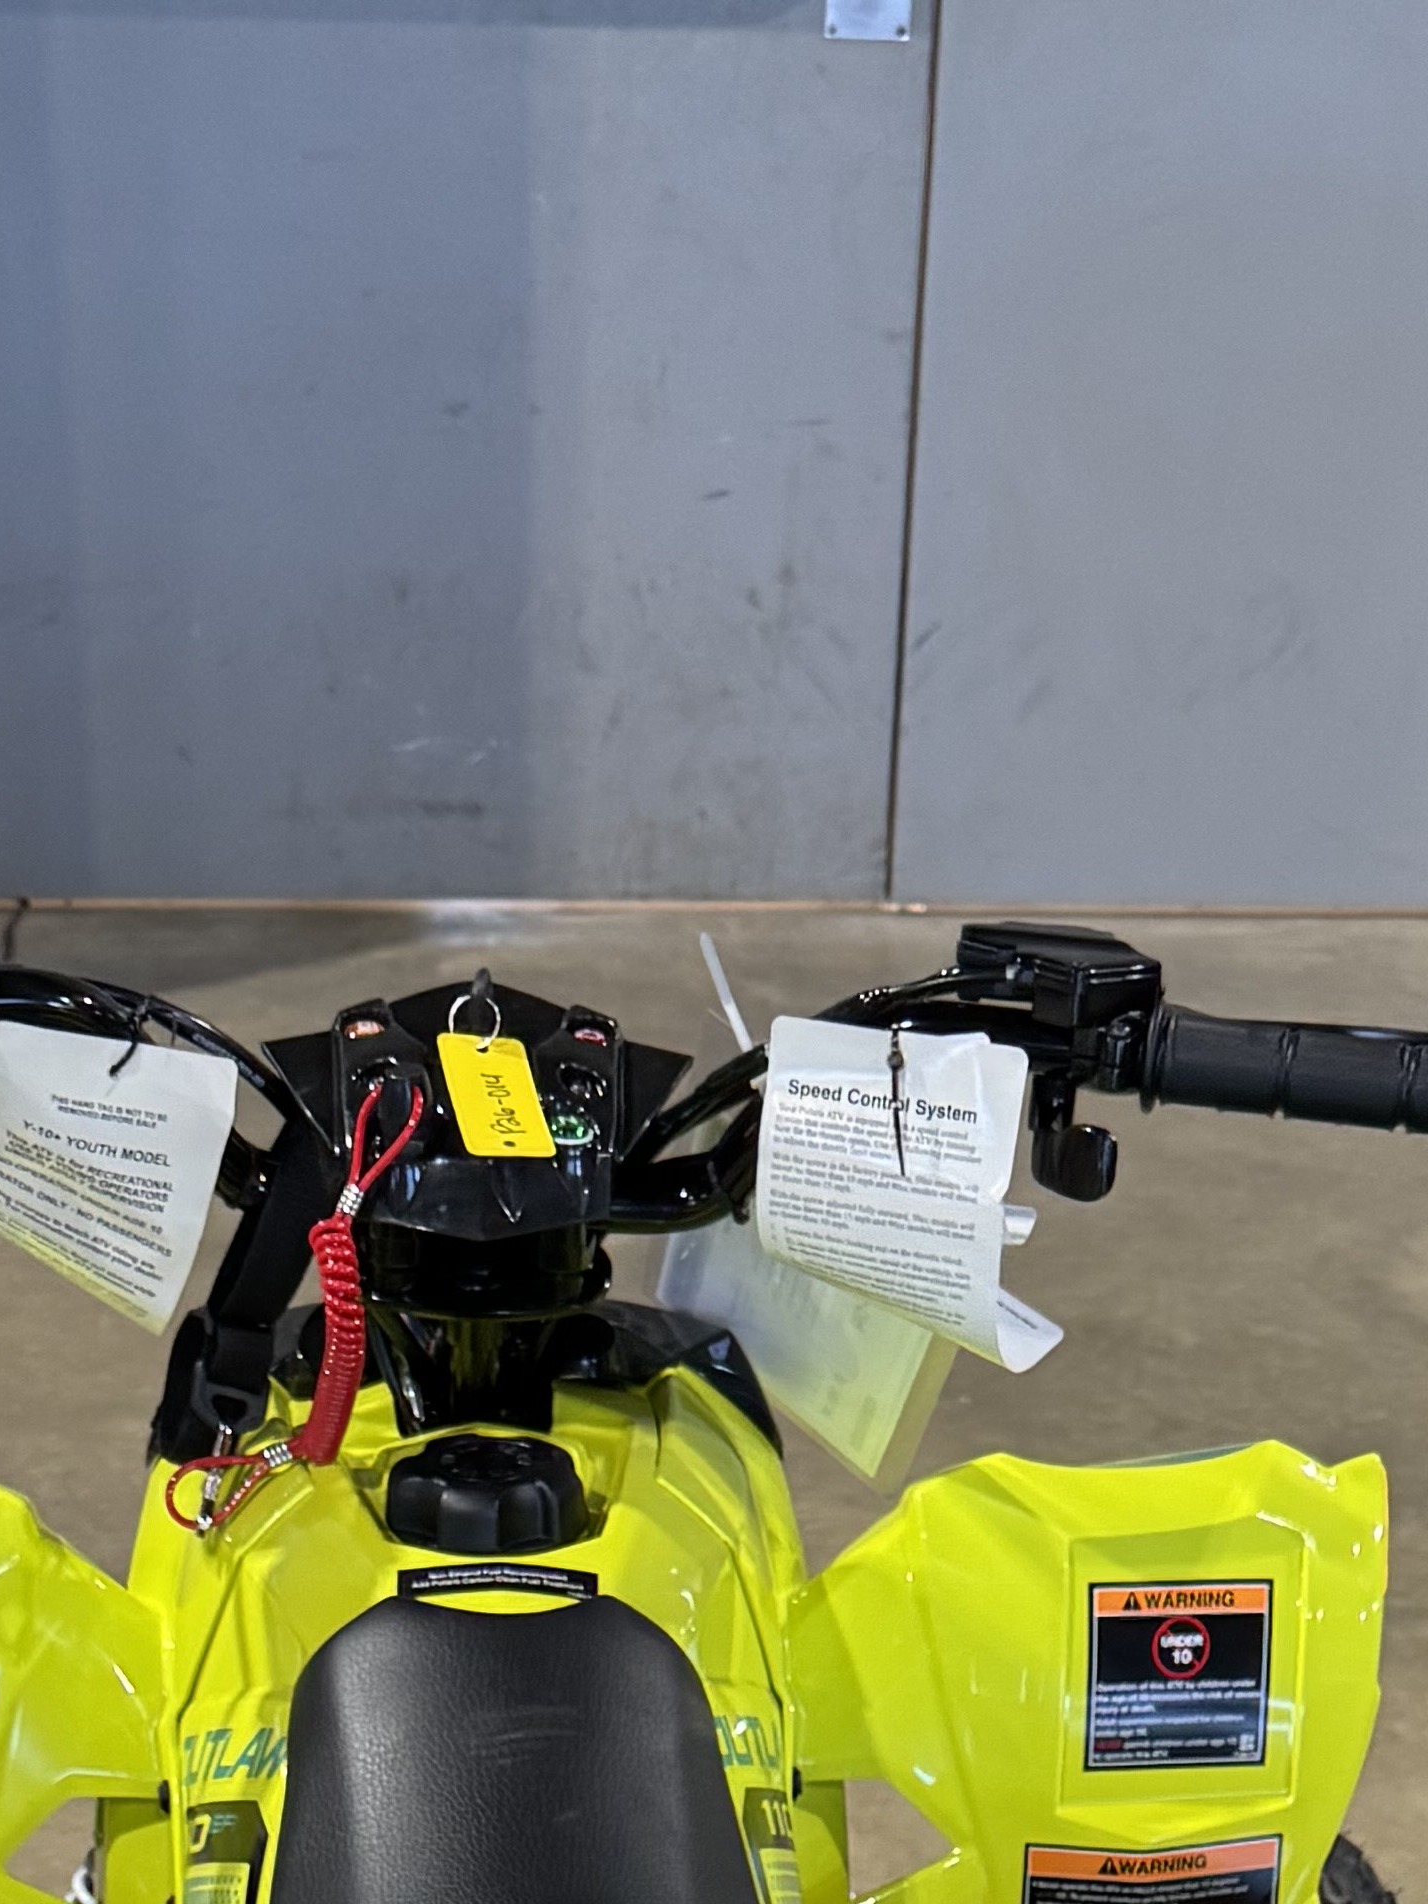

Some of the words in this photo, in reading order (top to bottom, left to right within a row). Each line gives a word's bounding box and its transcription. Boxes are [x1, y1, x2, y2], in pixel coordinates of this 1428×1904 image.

[788, 1079, 842, 1101] Speed
[915, 1099, 978, 1124] System
[66, 1136, 117, 1158] YOUTH
[120, 1147, 171, 1167] MODEL
[88, 1165, 173, 1191] RECREATIONAL
[99, 1179, 169, 1203] OPERATORS
[1145, 1590, 1235, 1609] WARNING
[1172, 1649, 1193, 1665] 10
[1118, 1855, 1207, 1874] WARNING
